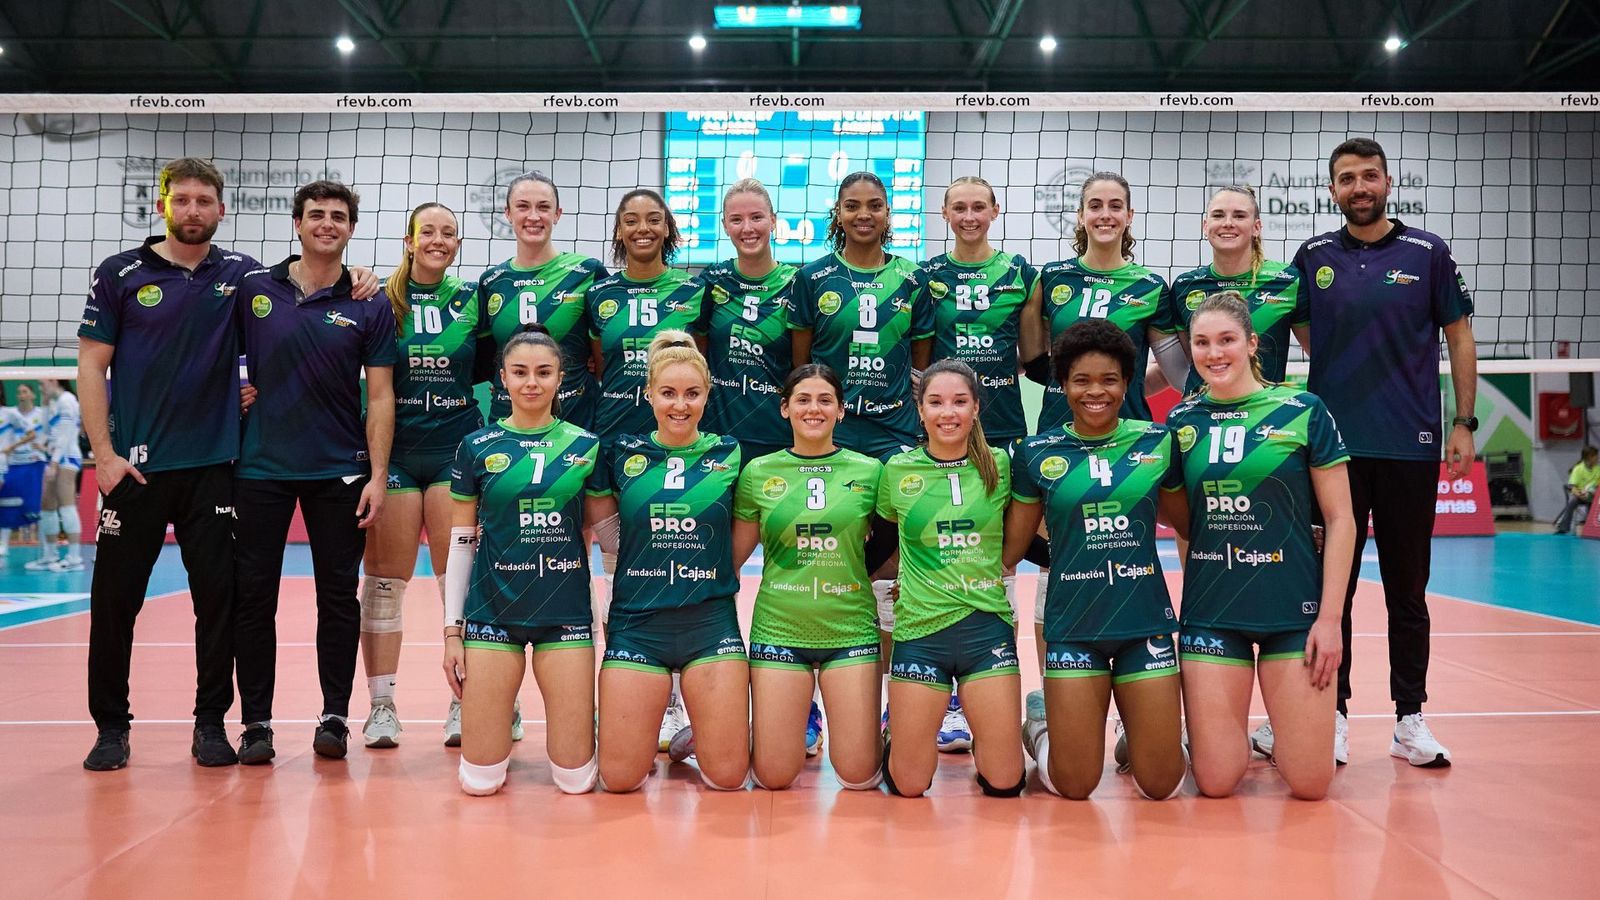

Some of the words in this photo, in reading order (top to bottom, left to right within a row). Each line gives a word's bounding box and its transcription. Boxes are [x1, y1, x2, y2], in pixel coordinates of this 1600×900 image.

[130, 95, 205, 107] rfevb.com
[337, 95, 411, 107] rfevb.com
[543, 95, 618, 106] rfevb.com
[749, 94, 824, 106] rfevb.com
[955, 94, 1029, 106] rfevb.com
[1160, 94, 1233, 105] rfevb.com
[1361, 94, 1433, 106] rfevb.com
[1561, 94, 1599, 106] rfevb
[1268, 171, 1332, 194] Ayunta
[230, 192, 294, 212] Herma
[1268, 199, 1310, 214] Dos
[955, 284, 990, 310] 23
[1079, 288, 1111, 318] 12
[519, 292, 537, 324] 6
[627, 299, 658, 326] 15
[742, 295, 760, 321] 5
[859, 294, 877, 328] 8
[411, 304, 442, 334] 10
[731, 323, 762, 340] FP
[955, 323, 987, 335] FP
[729, 336, 763, 356] PRO
[849, 342, 881, 355] FP
[955, 336, 994, 348] PRO
[408, 345, 445, 357] FP
[624, 350, 648, 363] PR
[408, 356, 450, 369] PRO
[848, 356, 885, 371] PRO
[848, 371, 886, 379] FORMACIÓN
[433, 396, 467, 409] Cajasol
[1208, 425, 1246, 464] 19
[129, 444, 148, 465] MS
[530, 453, 545, 484] 7
[664, 457, 685, 489] 2
[1088, 455, 1113, 487] 4
[806, 478, 826, 510] 3
[947, 473, 963, 506] 1
[1202, 479, 1243, 495] FP
[518, 498, 555, 512] FP
[650, 503, 690, 517] FP
[1082, 501, 1122, 518] FP
[1206, 495, 1250, 513] PRO
[519, 512, 562, 527] PRO
[1084, 515, 1129, 533] PRO
[1207, 513, 1255, 521] FORMACIÓN
[520, 527, 565, 535] FORMACIÓN
[650, 518, 697, 533] PRO
[796, 523, 832, 536] FP
[936, 519, 975, 534] FP
[1208, 523, 1264, 531] PROFESIONAL
[652, 533, 699, 541] FORMACIÓN
[797, 536, 838, 551] PRO
[938, 532, 981, 548] PRO
[1086, 532, 1133, 541] FORMACIÓN
[652, 542, 706, 550] PROFESIONAL
[940, 548, 984, 556] FORMACIÓN
[1087, 540, 1141, 550] PROFESIONAL
[797, 551, 841, 559] FORMACIÓN
[1235, 550, 1284, 567] Cajasol
[494, 562, 536, 571] Fundación
[626, 568, 667, 577] Fundación
[1060, 570, 1105, 581] Fundación
[1116, 563, 1155, 579] Cajasol
[769, 581, 810, 592] Fundación
[1181, 635, 1224, 649] MAX
[751, 643, 794, 656] MAX
[751, 653, 794, 662] COLCHON
[1047, 652, 1092, 662] MAX
[893, 663, 937, 677] MAX
[893, 672, 937, 683] COLCHON
